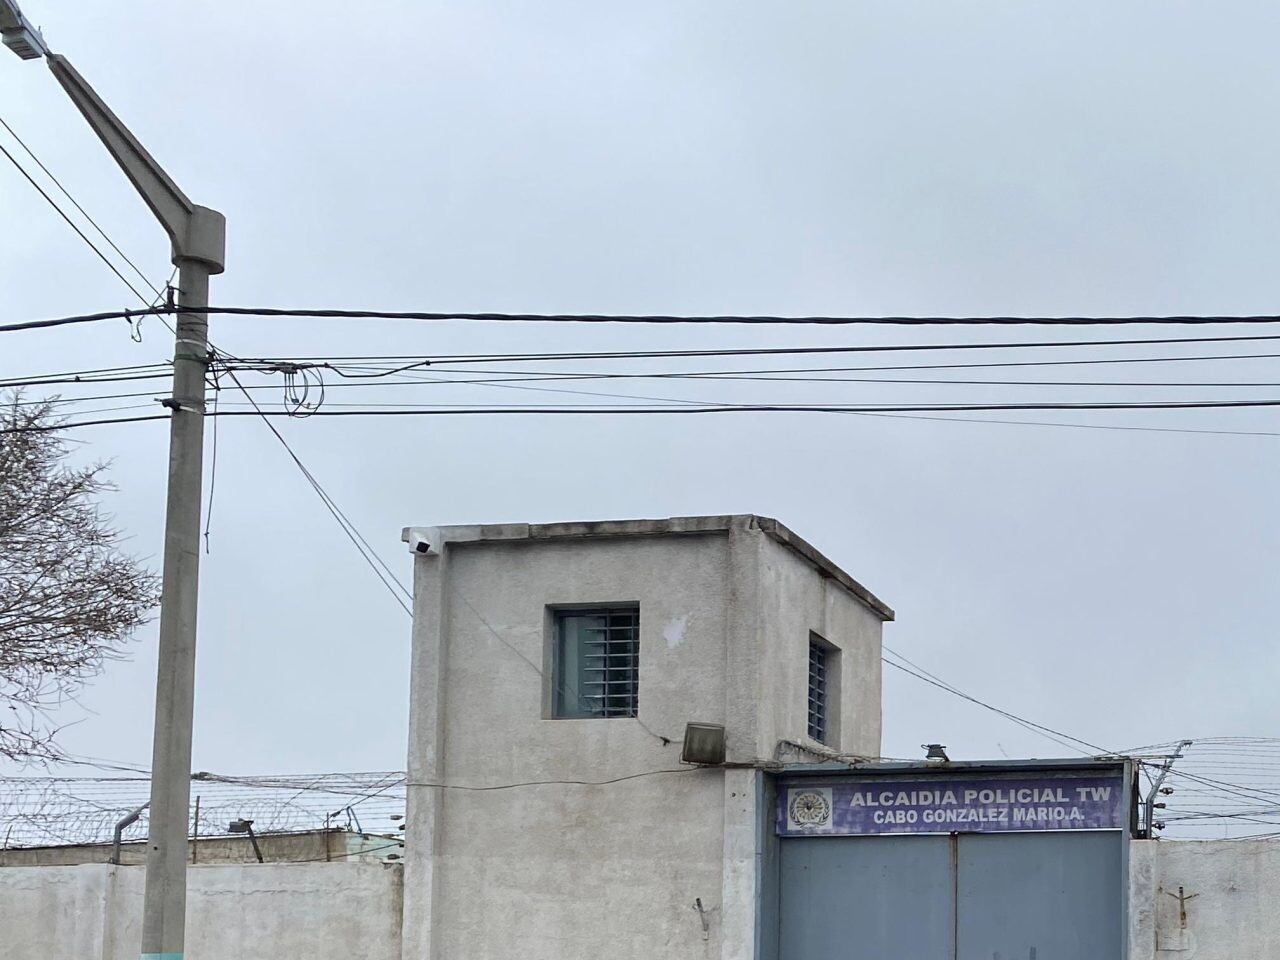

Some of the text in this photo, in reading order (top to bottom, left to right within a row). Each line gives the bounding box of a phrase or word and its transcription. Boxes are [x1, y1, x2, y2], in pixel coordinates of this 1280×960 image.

[850, 787, 1111, 807] ALCAIDIA POLICIAL TW
[873, 810, 918, 824] CABO
[922, 808, 1008, 823] GONZALEZ
